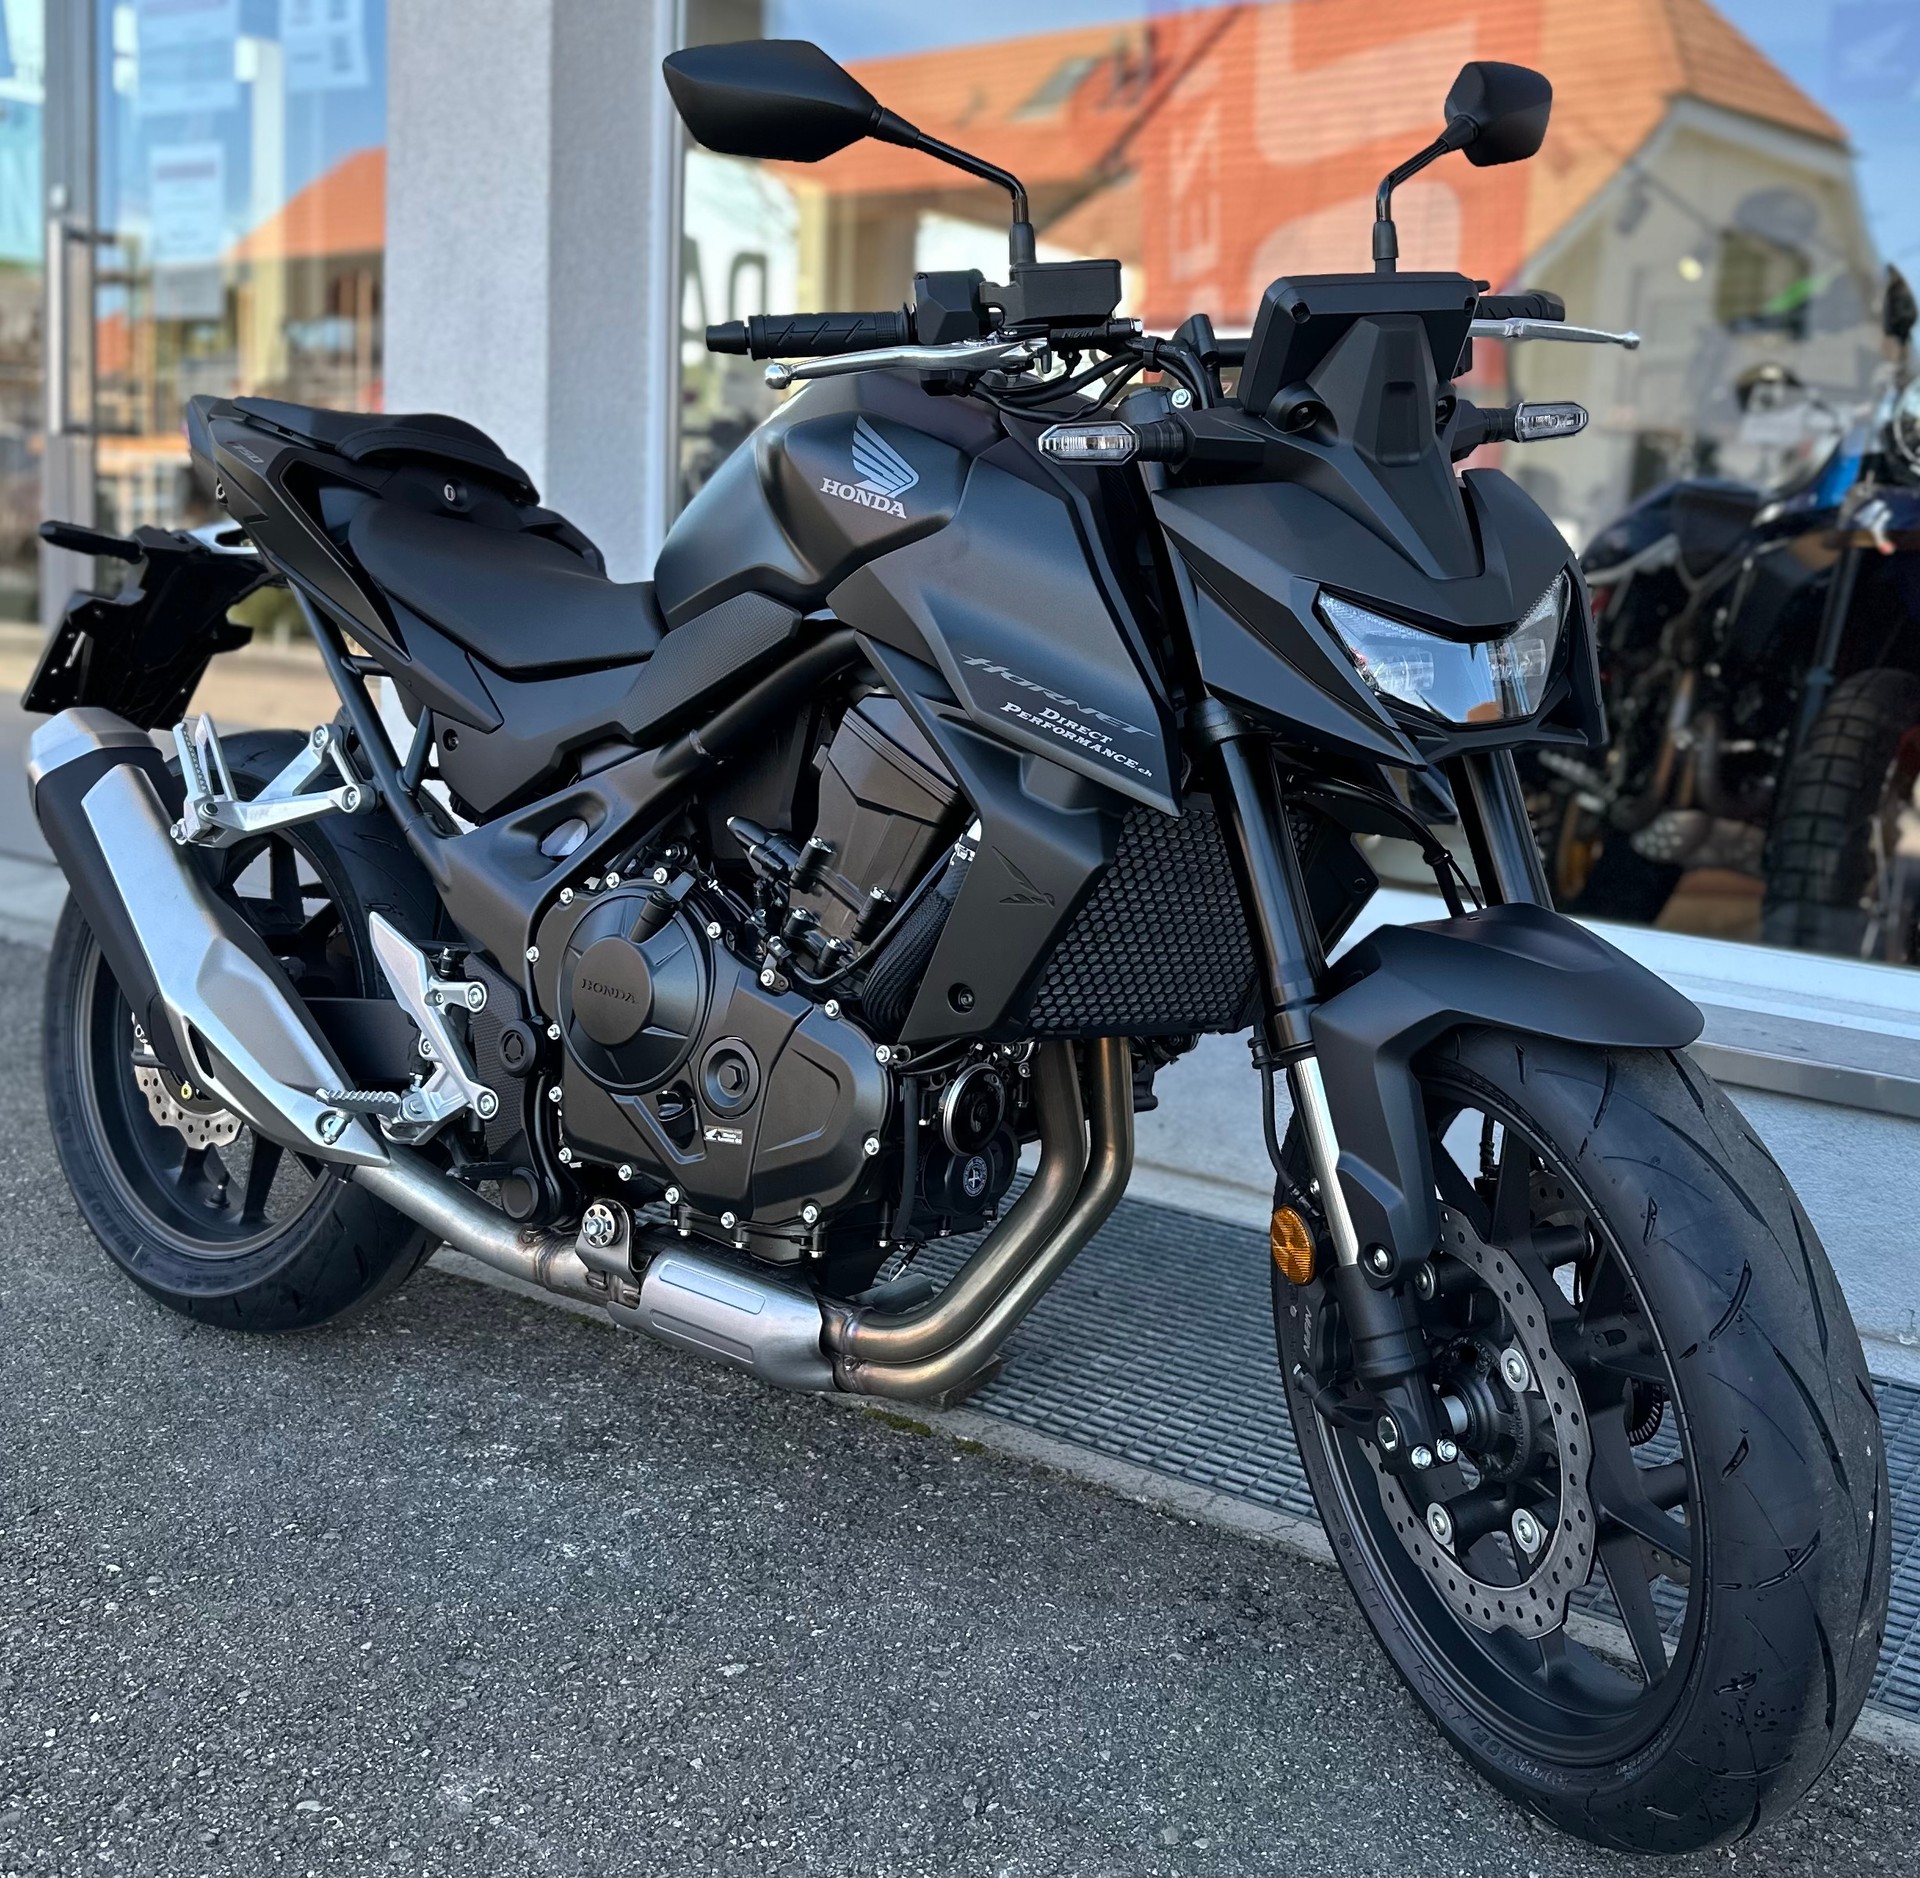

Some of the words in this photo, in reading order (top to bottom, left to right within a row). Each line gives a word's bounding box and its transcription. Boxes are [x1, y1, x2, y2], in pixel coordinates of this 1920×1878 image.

[820, 477, 907, 519] HONDA
[960, 653, 1156, 737] HORNET
[581, 978, 636, 1003] HONDA
